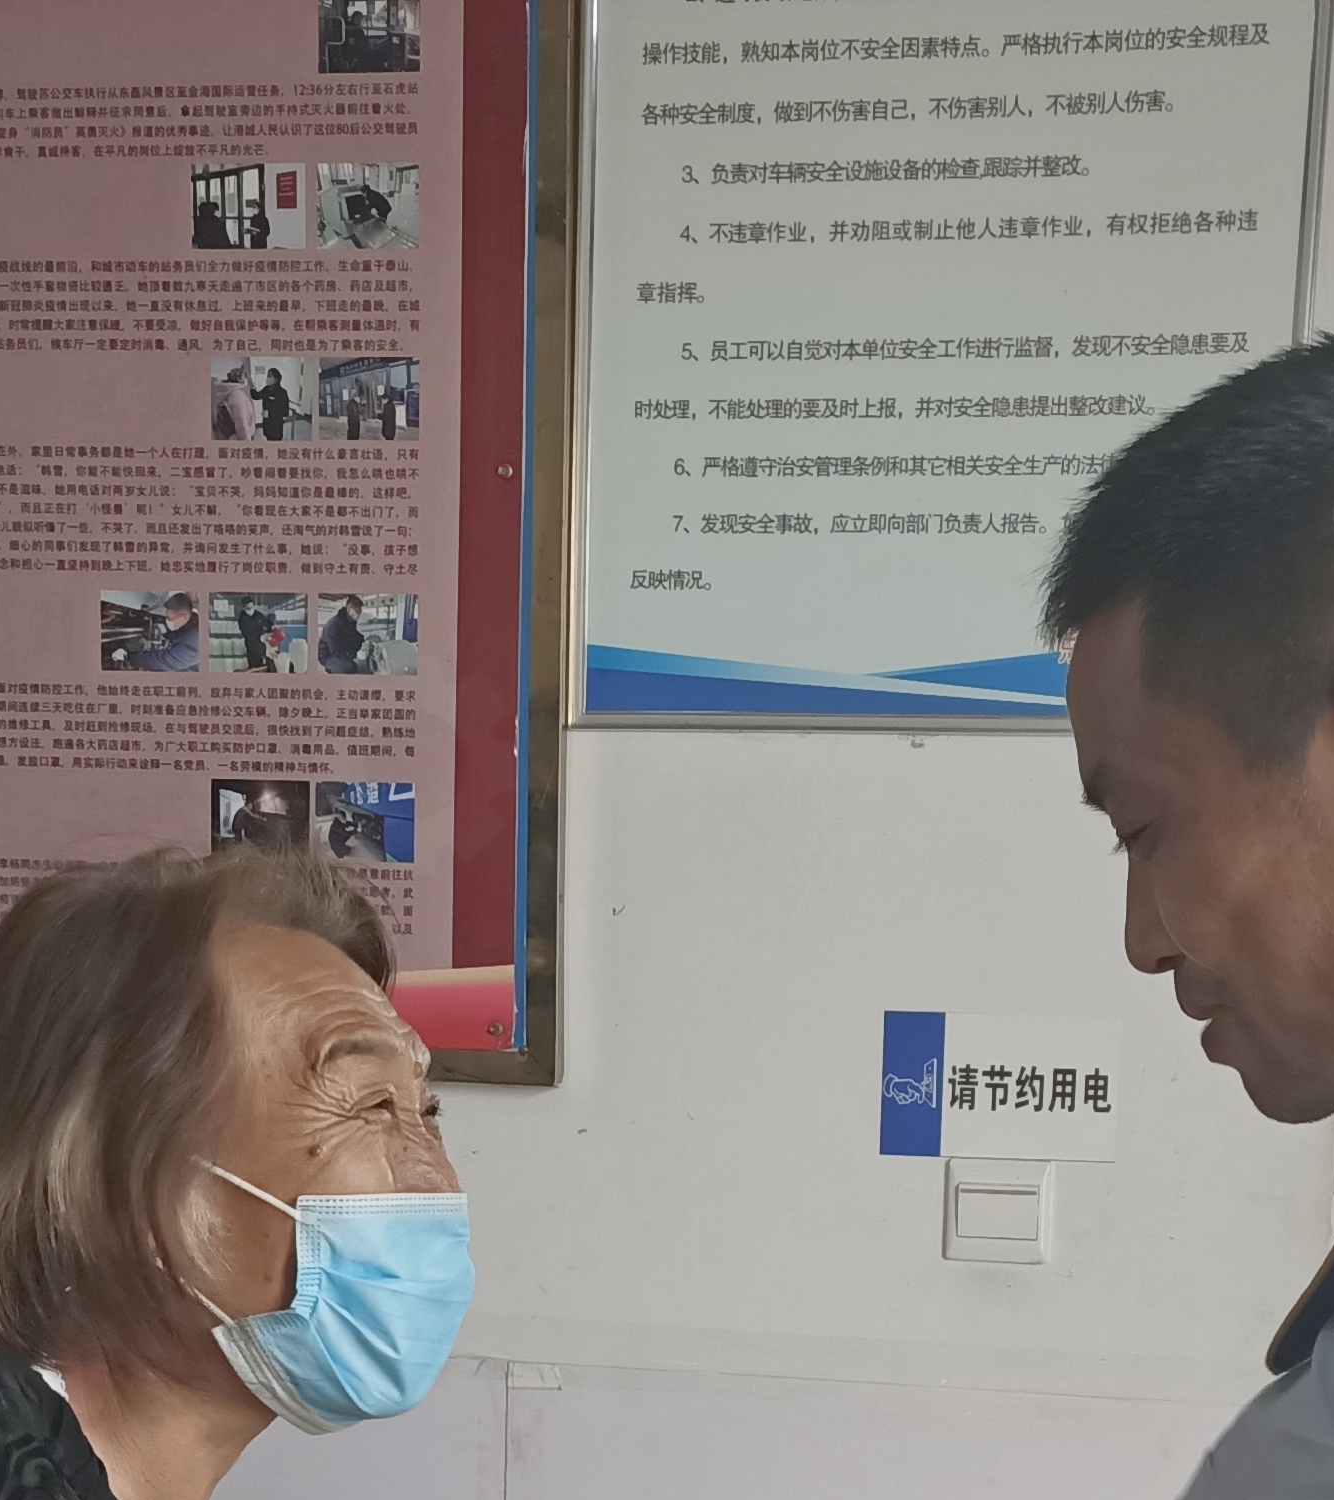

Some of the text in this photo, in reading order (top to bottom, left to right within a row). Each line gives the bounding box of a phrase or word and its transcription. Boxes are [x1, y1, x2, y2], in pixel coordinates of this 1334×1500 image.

[641, 90, 1175, 127] 各种安全制度，做到不伤害自己，不伤害别人，不被别人伤害。
[636, 281, 707, 306] 章指挥。
[629, 567, 715, 593] 反映情况。
[948, 1063, 1112, 1113] 请节约用电
